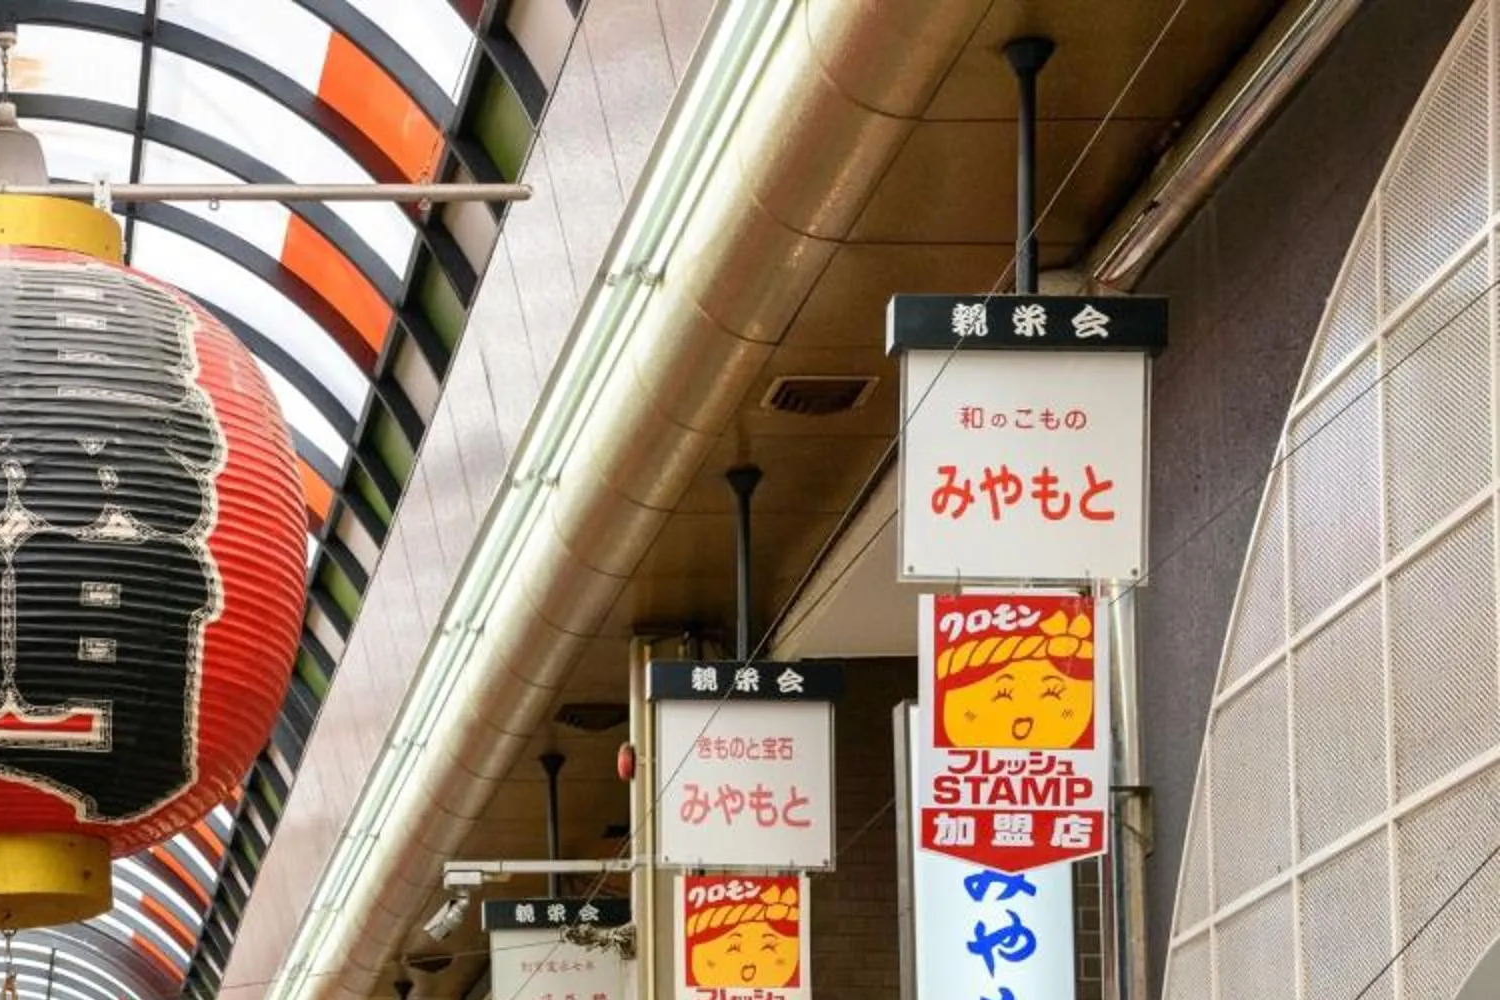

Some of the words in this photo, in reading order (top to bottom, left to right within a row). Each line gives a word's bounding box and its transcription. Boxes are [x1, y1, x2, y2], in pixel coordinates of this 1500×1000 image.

[959, 406, 1088, 431] 和のこもの
[931, 464, 1116, 521] みやもと
[938, 603, 1042, 643] クロモン
[698, 736, 794, 761] きものと宝石
[946, 750, 1077, 777] フレッシュ
[680, 782, 813, 829] みやもと
[932, 776, 1094, 807] STAMP
[932, 811, 1094, 849] 加盟店
[687, 879, 762, 909] クロモン
